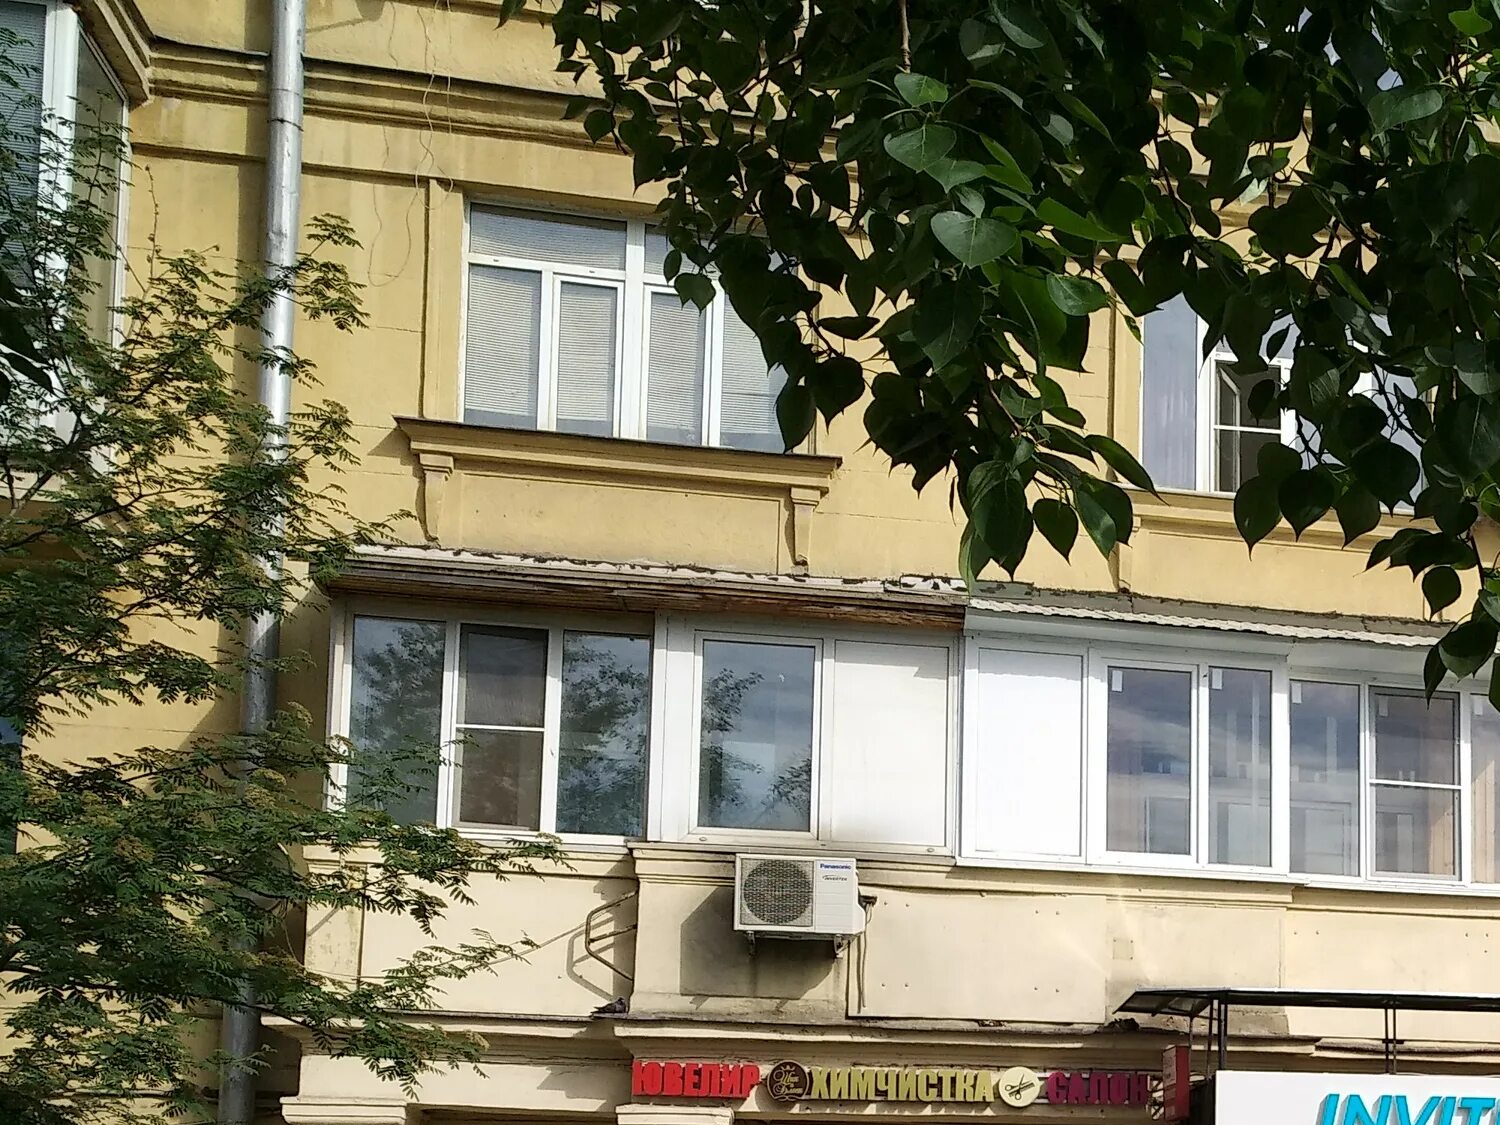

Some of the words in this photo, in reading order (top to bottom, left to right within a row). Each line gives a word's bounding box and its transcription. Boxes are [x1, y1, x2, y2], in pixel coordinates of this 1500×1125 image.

[819, 862, 852, 870] Panasonic
[632, 1060, 760, 1098] ЮВЕЛИР
[809, 1067, 995, 1103] ХИМЧИСТКА
[1047, 1071, 1150, 1105] САЛОН
